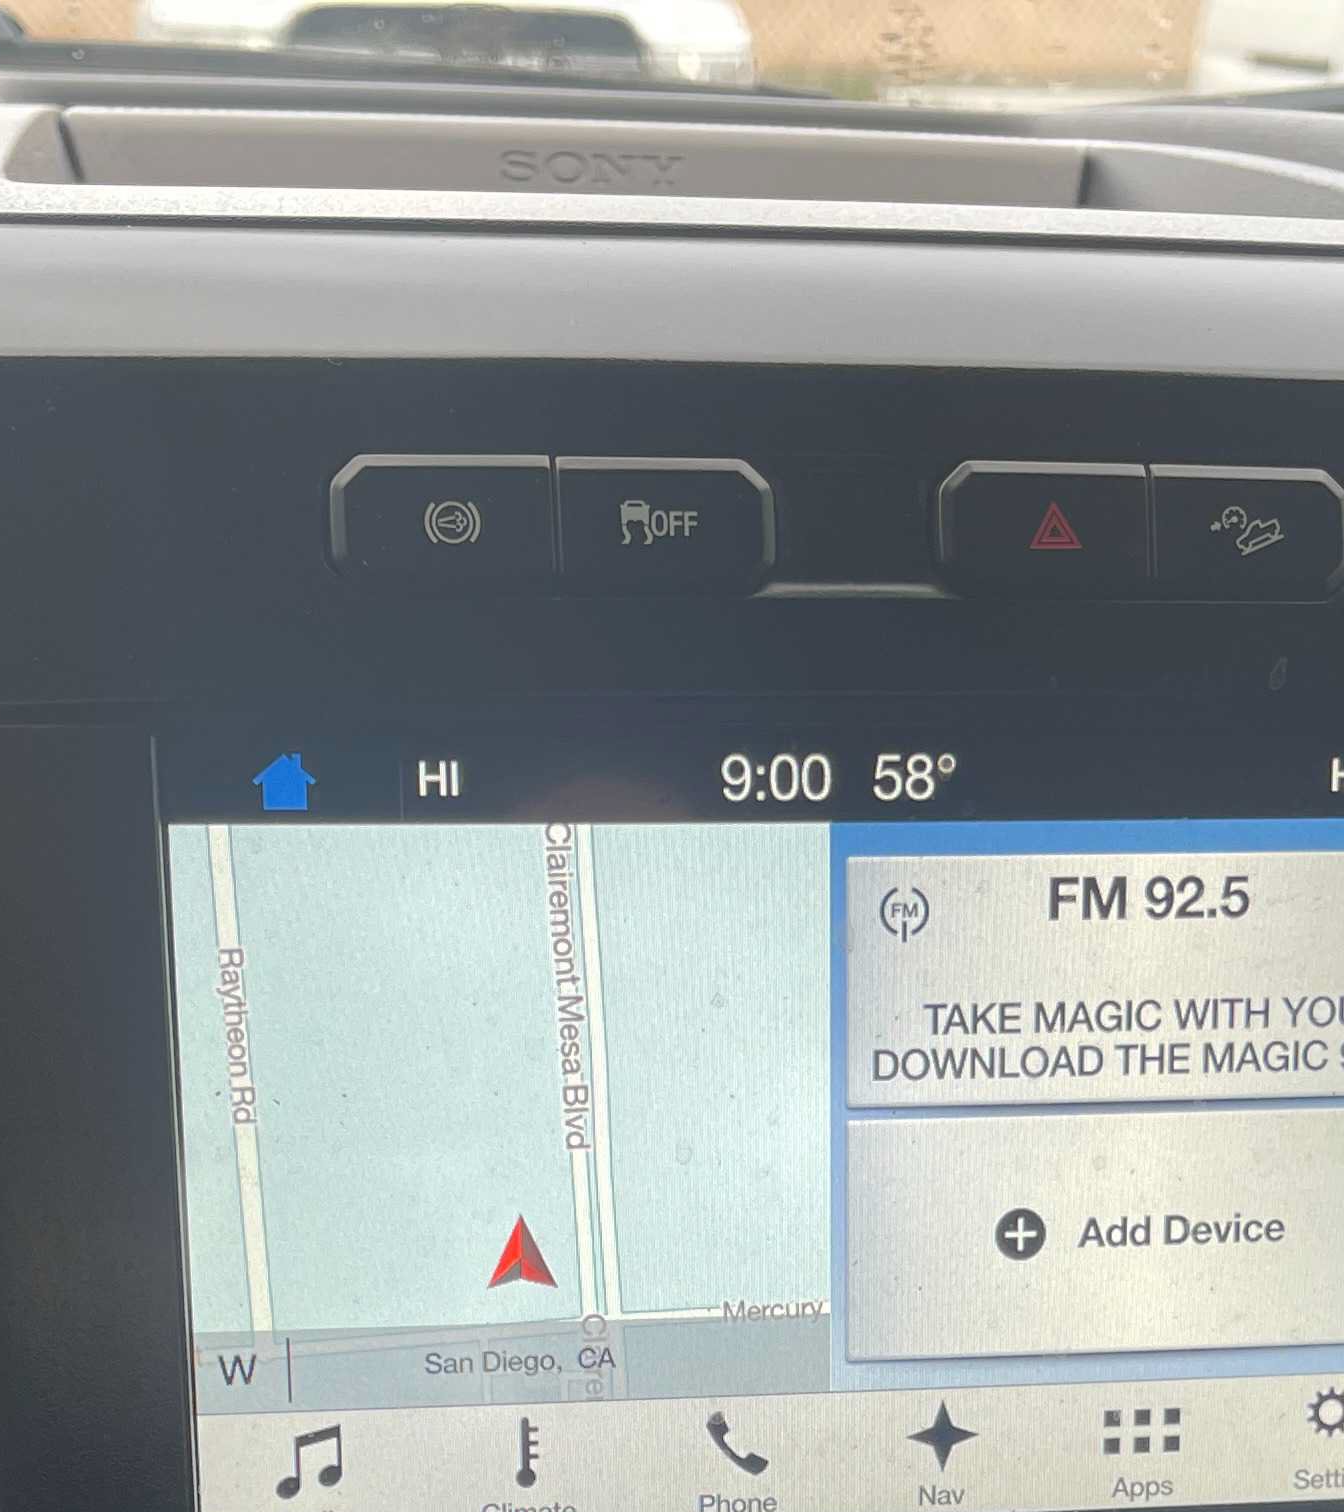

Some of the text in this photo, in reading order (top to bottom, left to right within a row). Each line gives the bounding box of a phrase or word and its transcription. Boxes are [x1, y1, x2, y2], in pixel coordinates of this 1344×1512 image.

[499, 150, 686, 186] SONY
[651, 510, 698, 537] OFF
[418, 760, 459, 797] HI
[720, 753, 832, 801] 9:00
[872, 753, 956, 801] 58°
[891, 903, 919, 918] FM
[1048, 876, 1250, 920] FM 92.5
[544, 824, 591, 1149] Clairemont Mesa Blvd
[923, 1002, 1021, 1035] TAKE
[1033, 999, 1162, 1032] MAGIC
[1173, 998, 1270, 1029] WITH
[216, 948, 258, 1124] Raytheon Rd
[872, 1044, 1104, 1082] DOWNLOAD
[1115, 1044, 1190, 1074] THE
[1201, 1040, 1328, 1072] MAGIC
[1078, 1213, 1285, 1248] Add Device
[722, 1299, 824, 1323] Mercury
[219, 1354, 257, 1386] W
[424, 1347, 616, 1377] San Diego, CA
[918, 1485, 965, 1505] Nav
[1112, 1476, 1173, 1499] Apps
